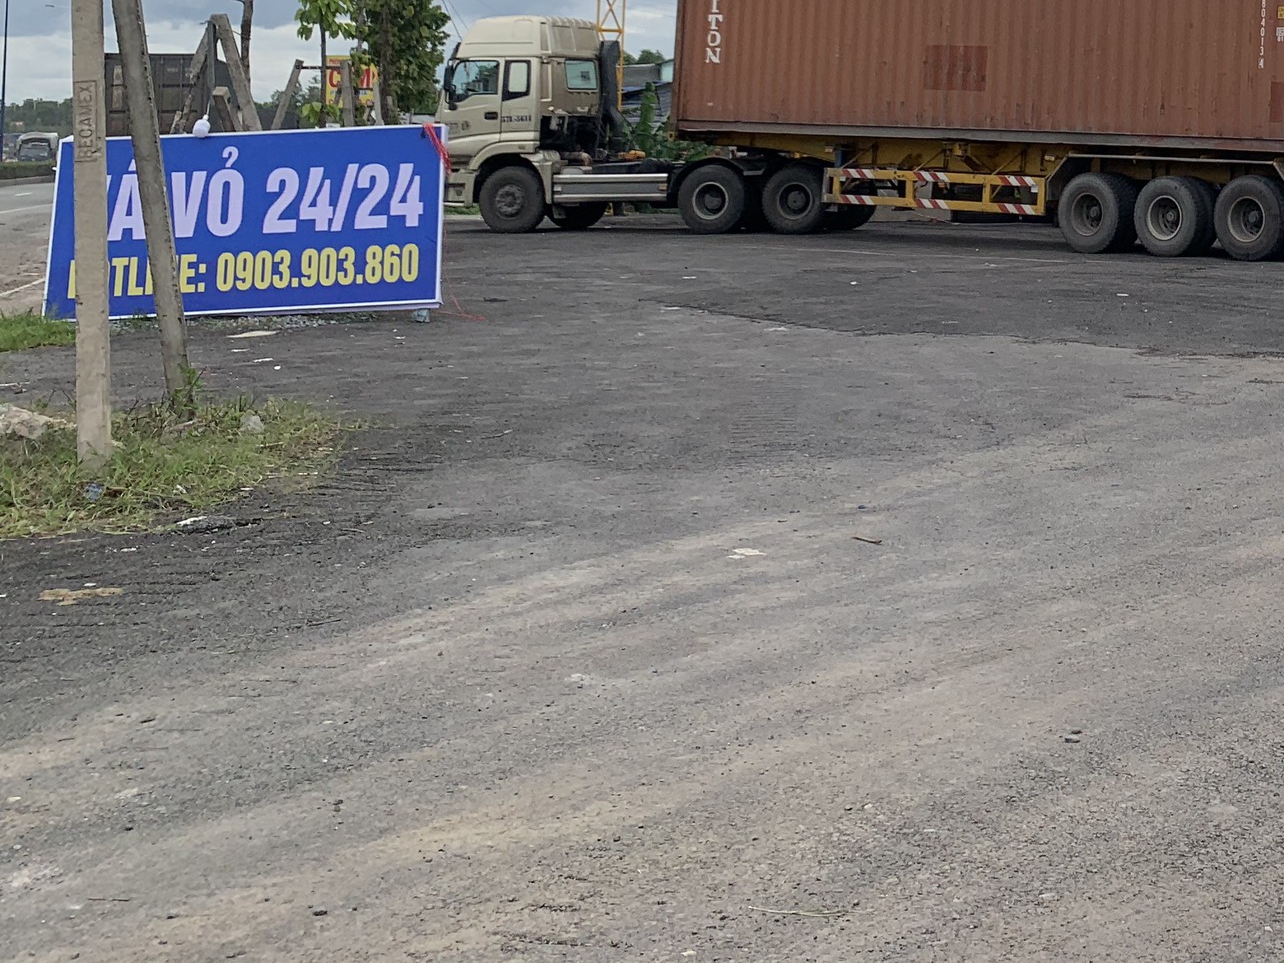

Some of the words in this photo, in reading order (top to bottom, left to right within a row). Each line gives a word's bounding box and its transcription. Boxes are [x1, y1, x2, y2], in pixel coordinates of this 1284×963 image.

[171, 146, 244, 239] VỎ
[262, 163, 424, 235] 24/24
[216, 243, 420, 292] 0903.903.860
